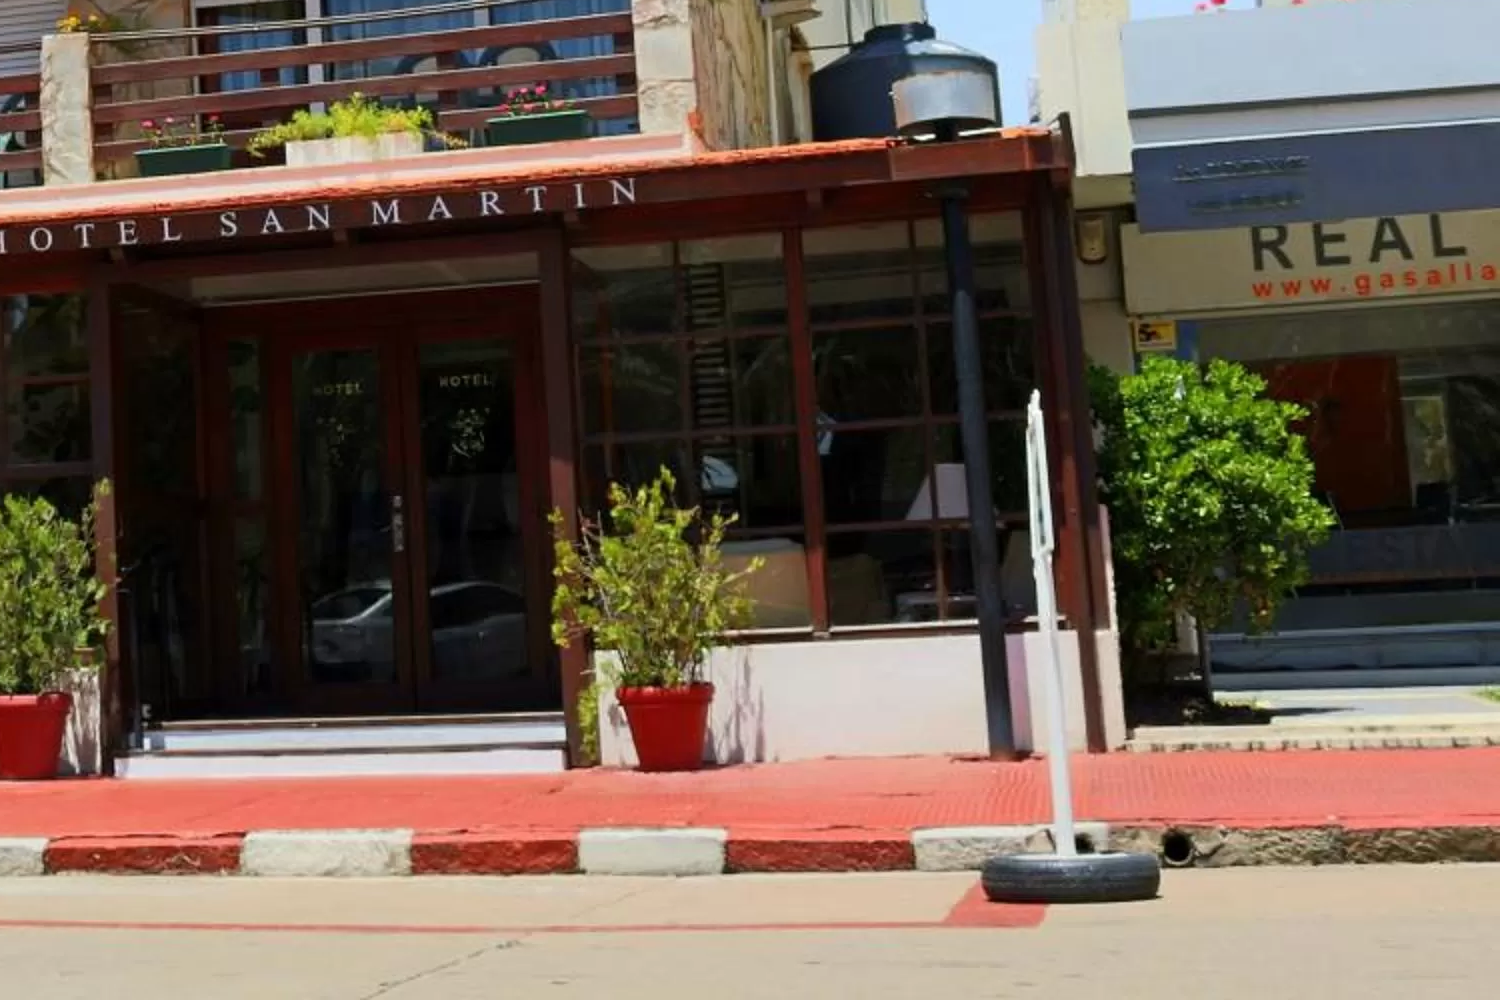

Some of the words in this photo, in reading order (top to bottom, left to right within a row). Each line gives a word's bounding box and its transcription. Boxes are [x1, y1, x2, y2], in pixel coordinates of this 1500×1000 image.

[219, 203, 332, 238] SAN
[371, 178, 638, 225] MARTIN
[1251, 213, 1467, 272] REAL
